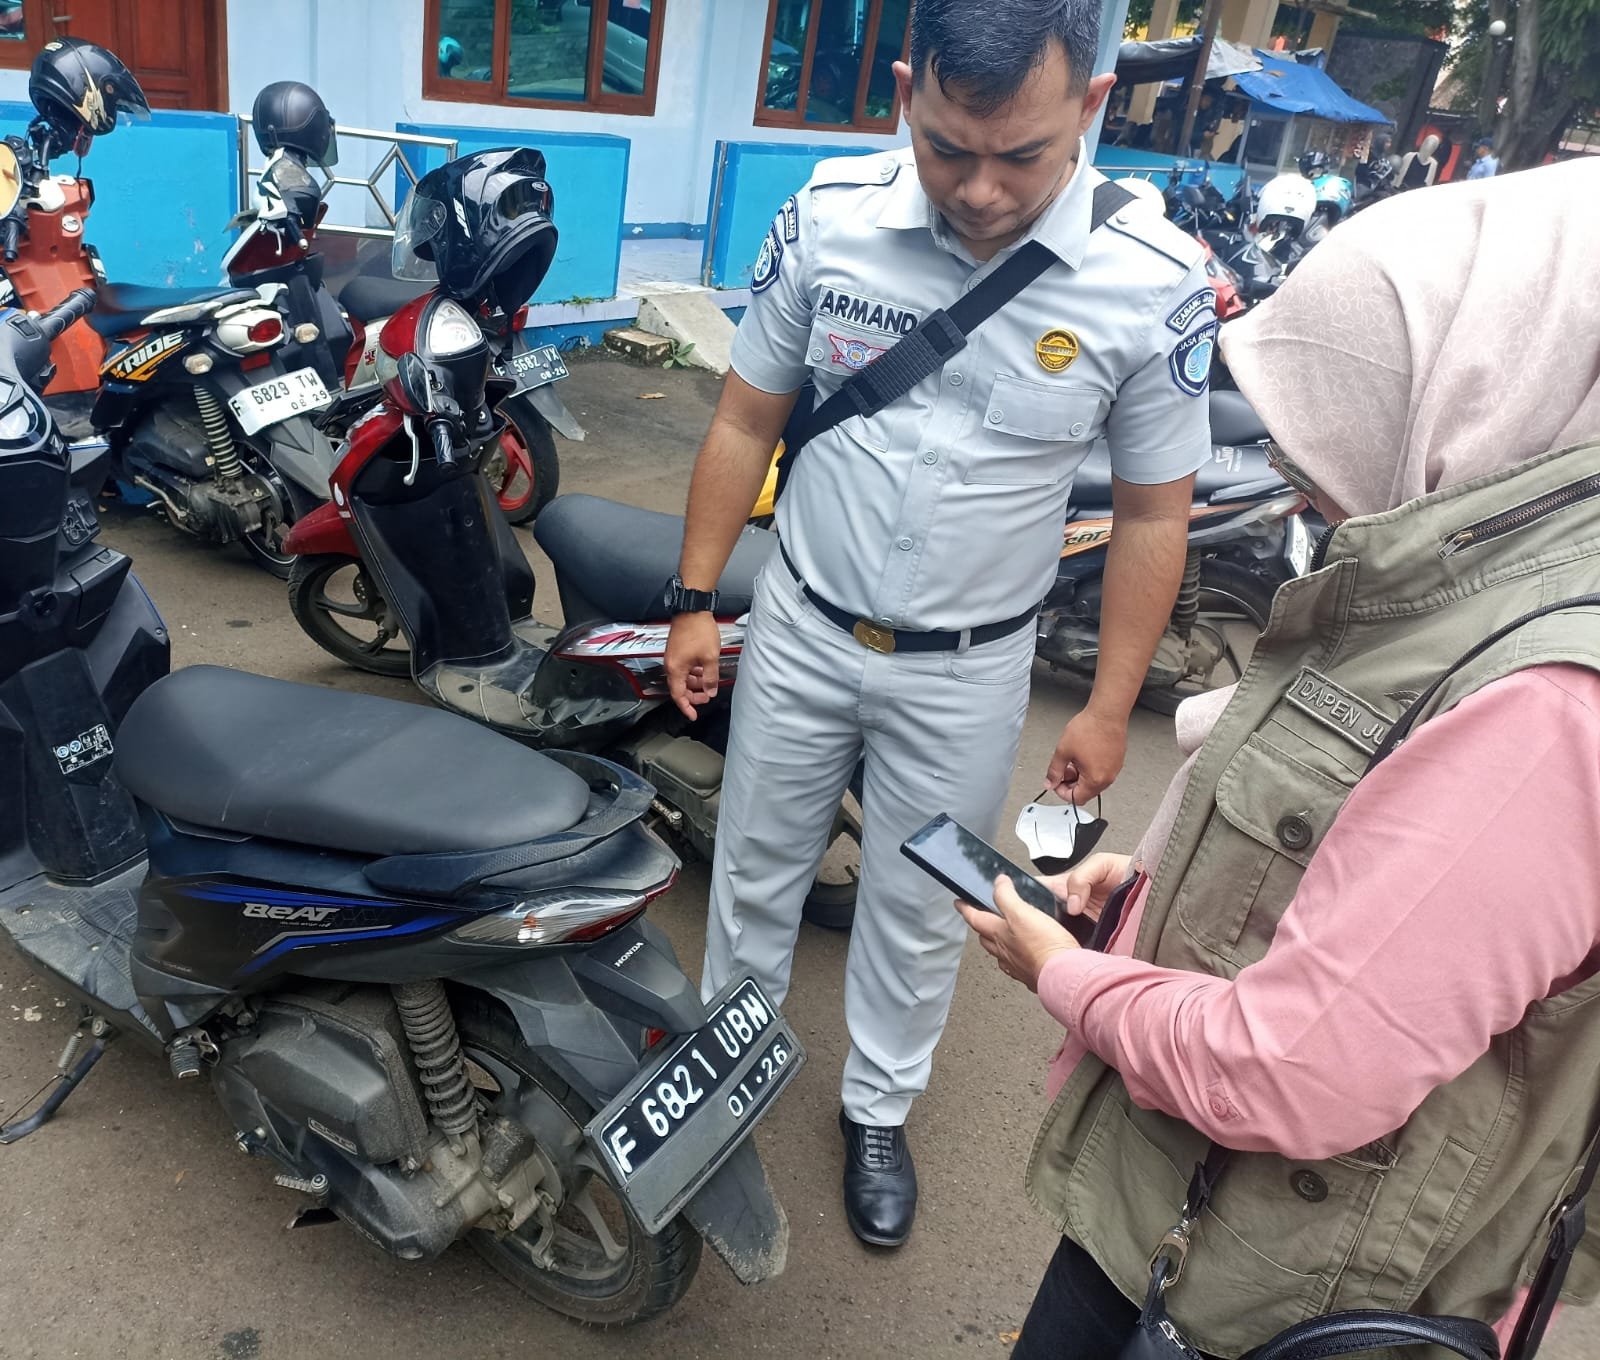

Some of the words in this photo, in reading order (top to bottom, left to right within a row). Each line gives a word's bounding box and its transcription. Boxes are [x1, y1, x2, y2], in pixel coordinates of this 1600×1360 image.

[513, 354, 541, 373] 5682
[543, 347, 560, 362] VX
[231, 400, 241, 417] F
[251, 381, 290, 405] 6829
[295, 372, 318, 388] TW
[1299, 680, 1361, 728] DAPEN
[614, 942, 644, 967] HONDA
[609, 1125, 637, 1174] F
[641, 1048, 718, 1137] 6821
